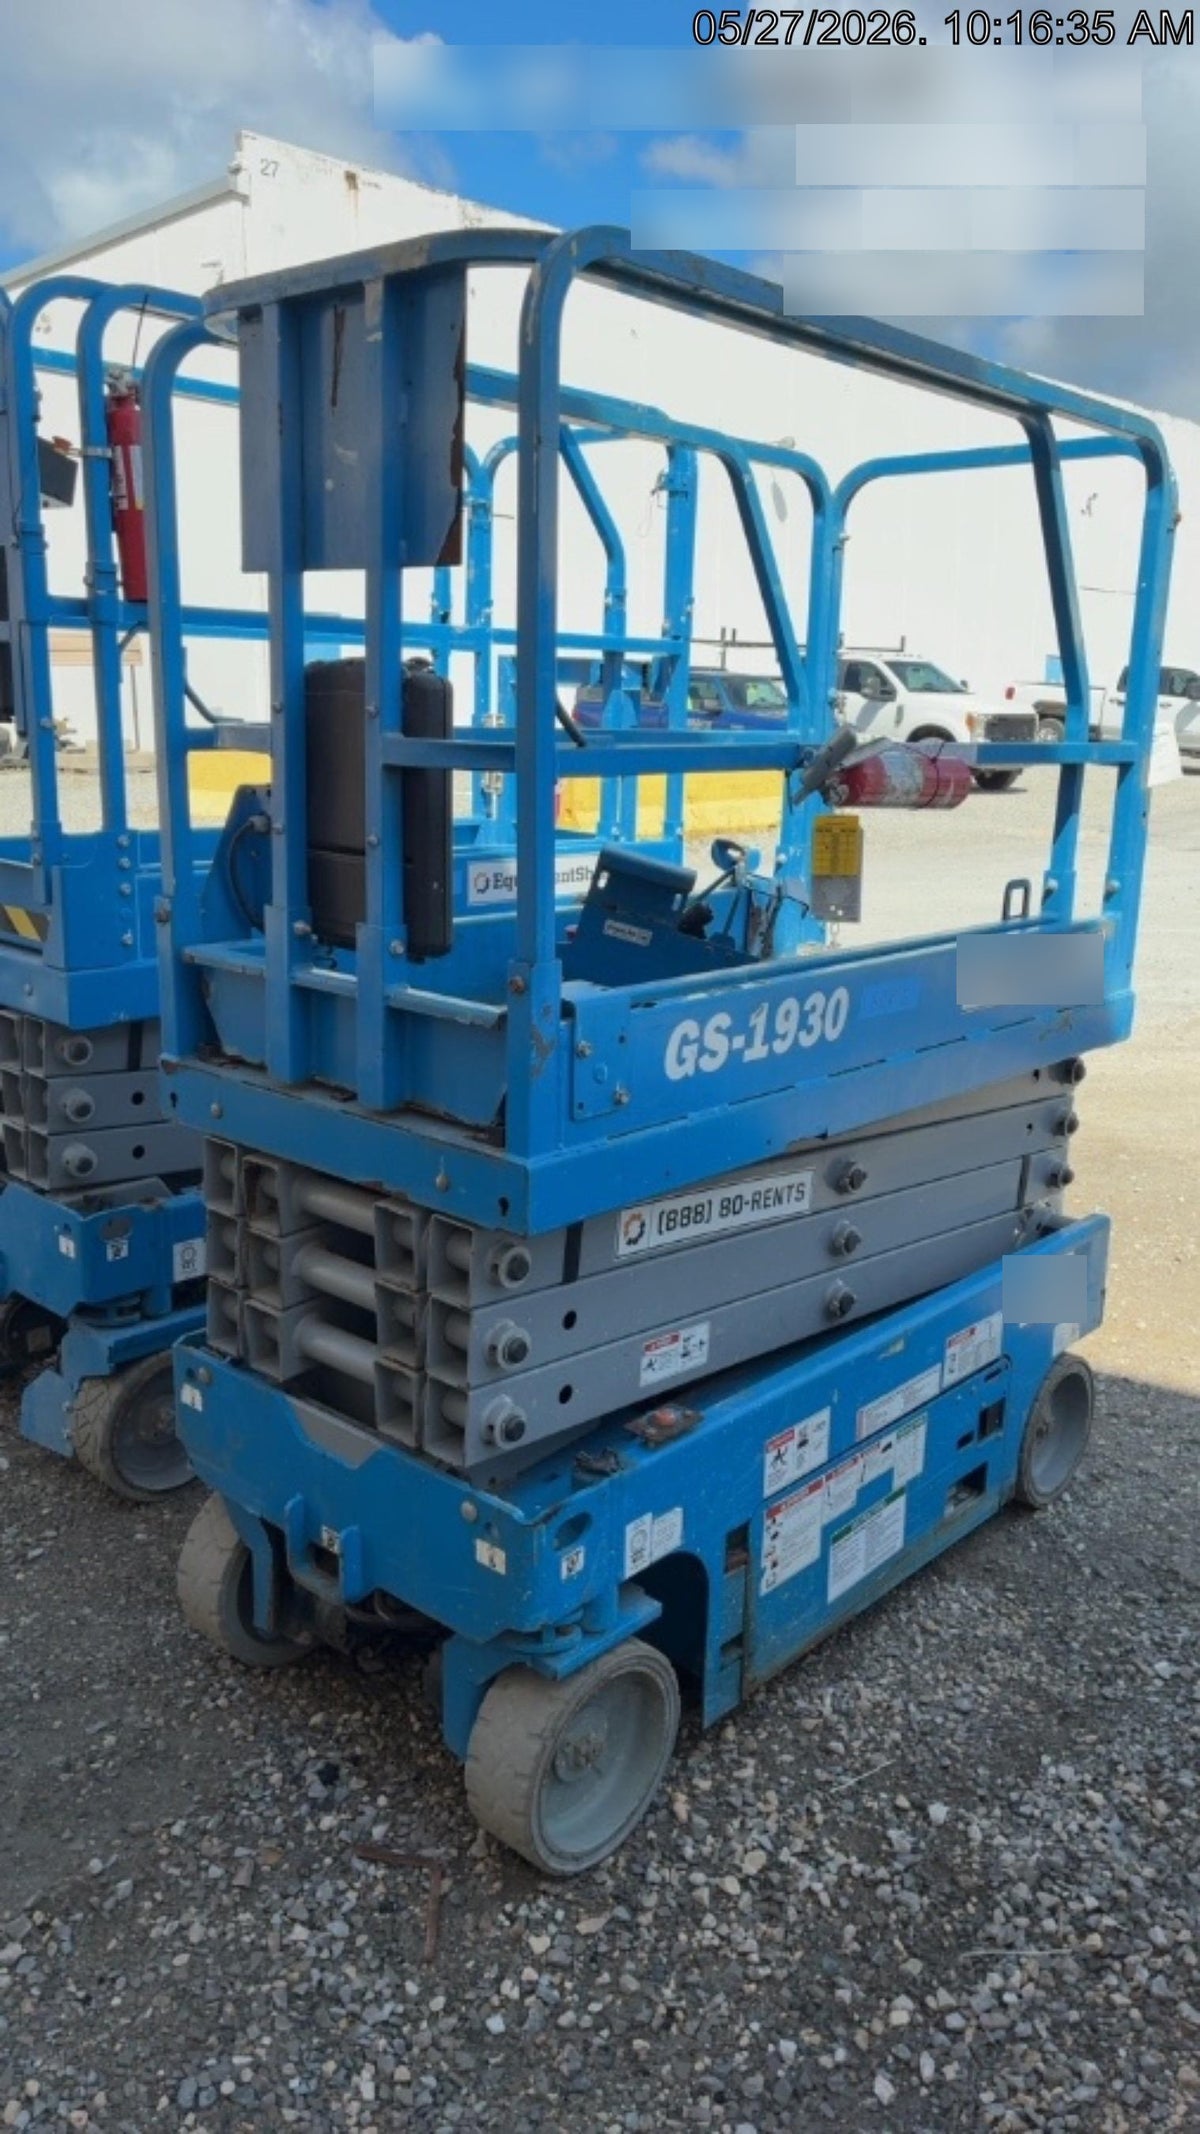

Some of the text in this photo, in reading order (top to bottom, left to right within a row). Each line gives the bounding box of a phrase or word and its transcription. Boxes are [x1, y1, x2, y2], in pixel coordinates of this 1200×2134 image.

[260, 158, 280, 178] 27
[664, 986, 850, 1081] GS-1930
[658, 1182, 806, 1236] (888) 80-RENTS
